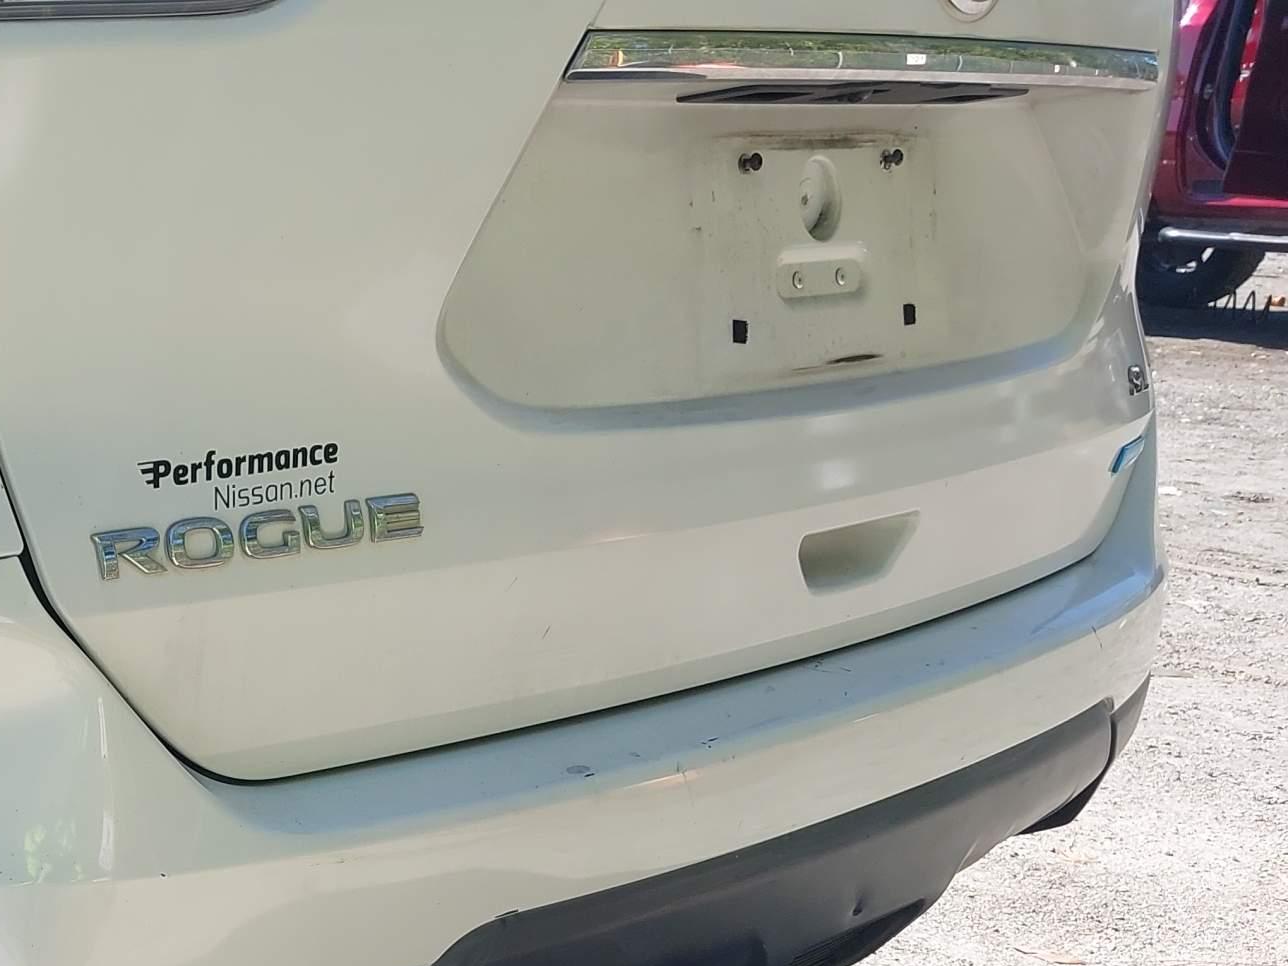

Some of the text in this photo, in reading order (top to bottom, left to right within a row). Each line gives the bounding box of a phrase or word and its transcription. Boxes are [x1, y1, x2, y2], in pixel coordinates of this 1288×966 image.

[137, 442, 339, 489] Performance
[214, 470, 336, 511] Nissan.net
[90, 492, 424, 581] ROGUE
